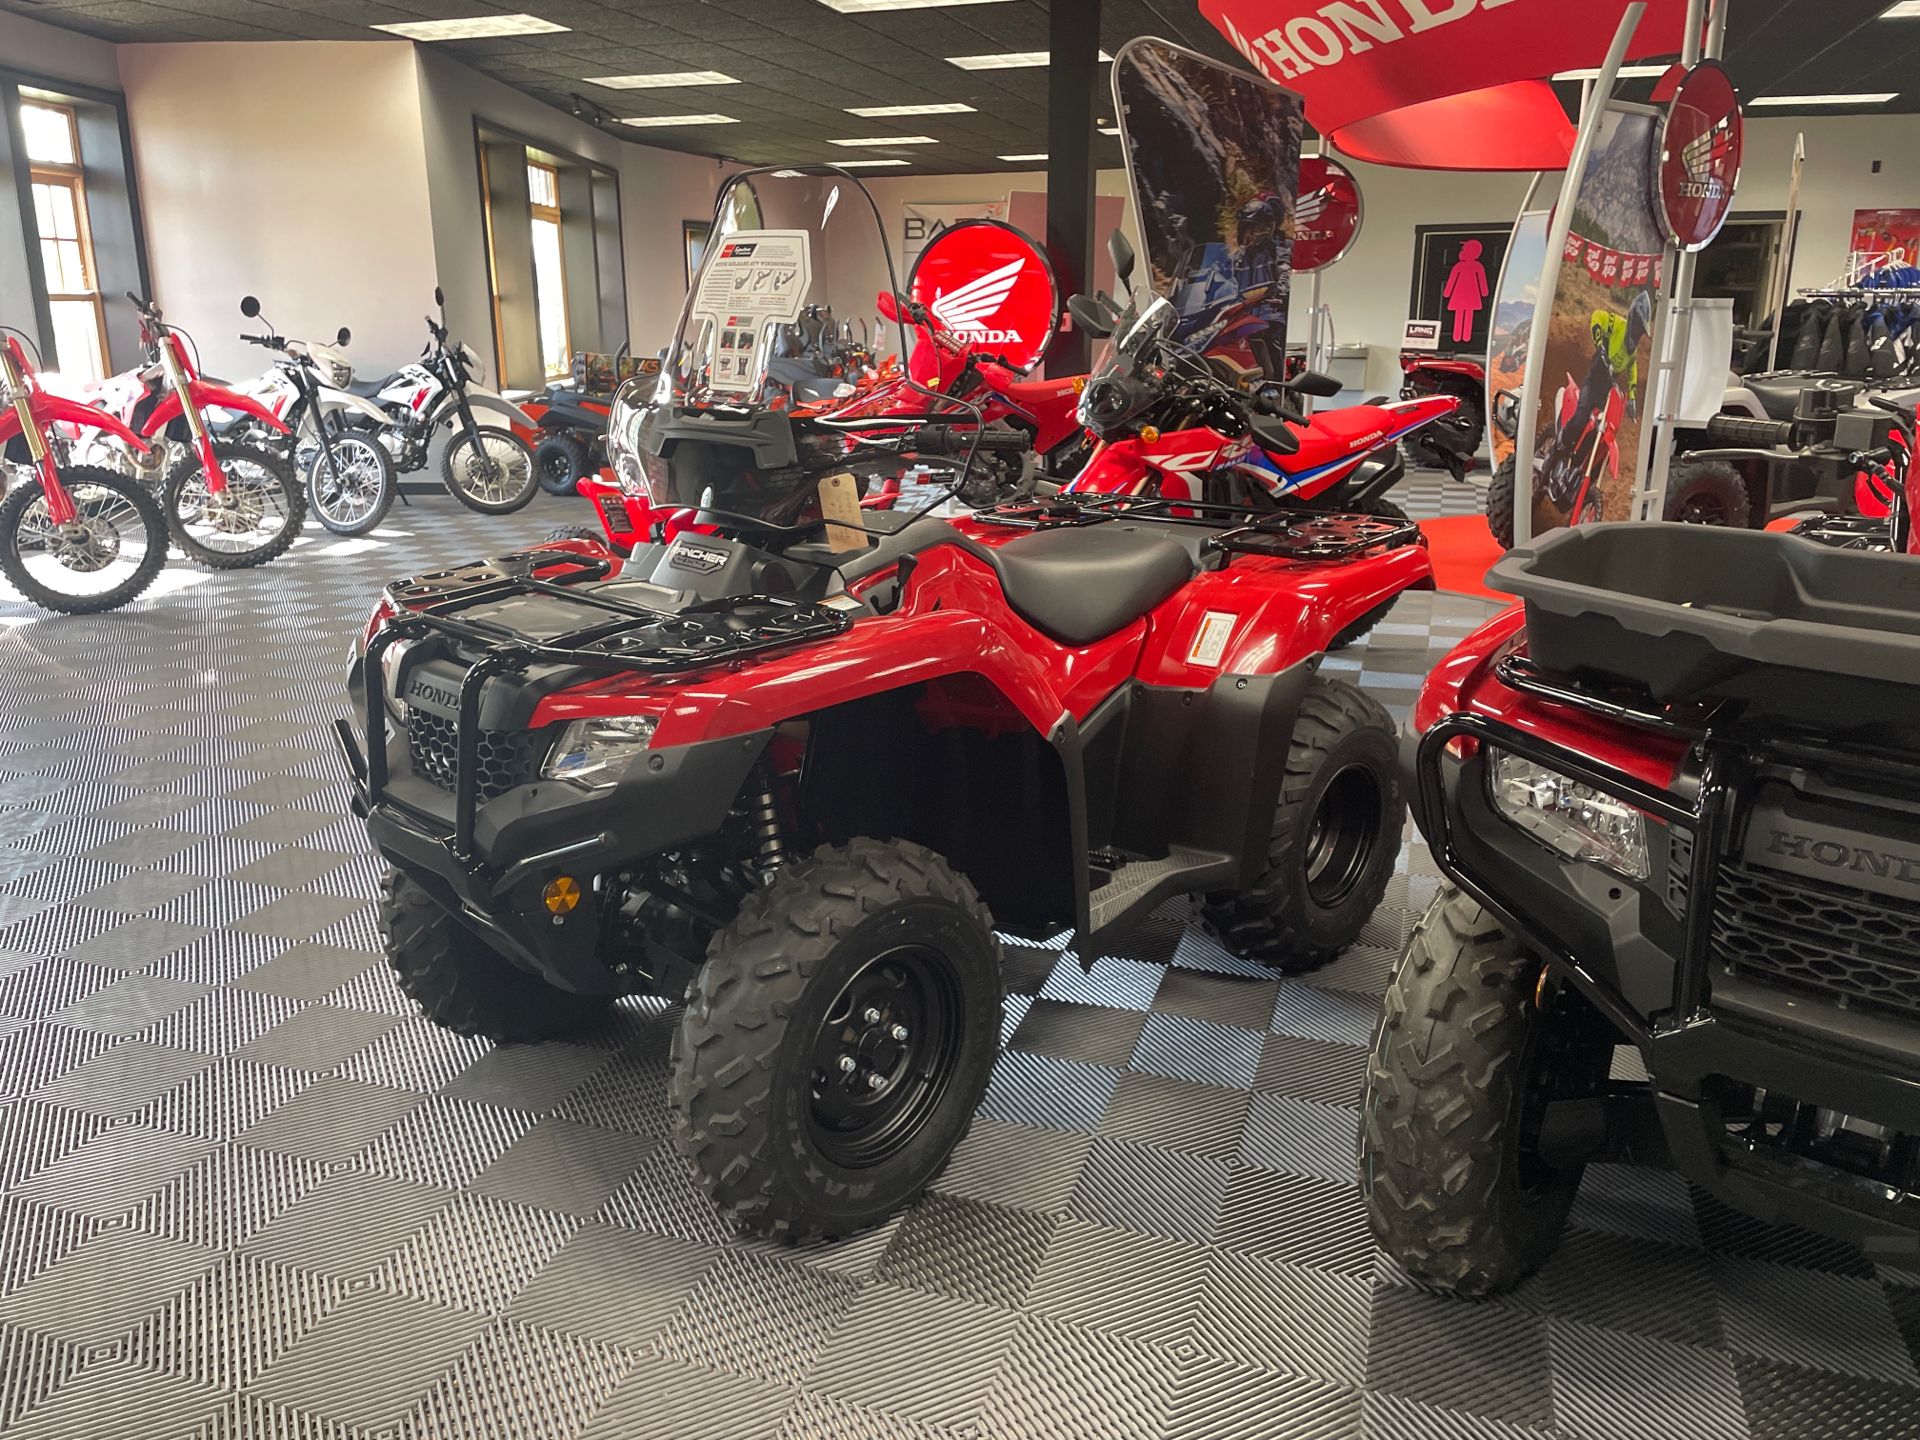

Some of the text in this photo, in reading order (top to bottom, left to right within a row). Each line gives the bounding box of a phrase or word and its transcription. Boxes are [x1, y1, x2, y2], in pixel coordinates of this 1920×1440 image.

[1678, 182, 1726, 199] HONDA
[940, 329, 1023, 343] ONDA
[1349, 430, 1383, 449] HONDA
[669, 545, 728, 566] RANCHER
